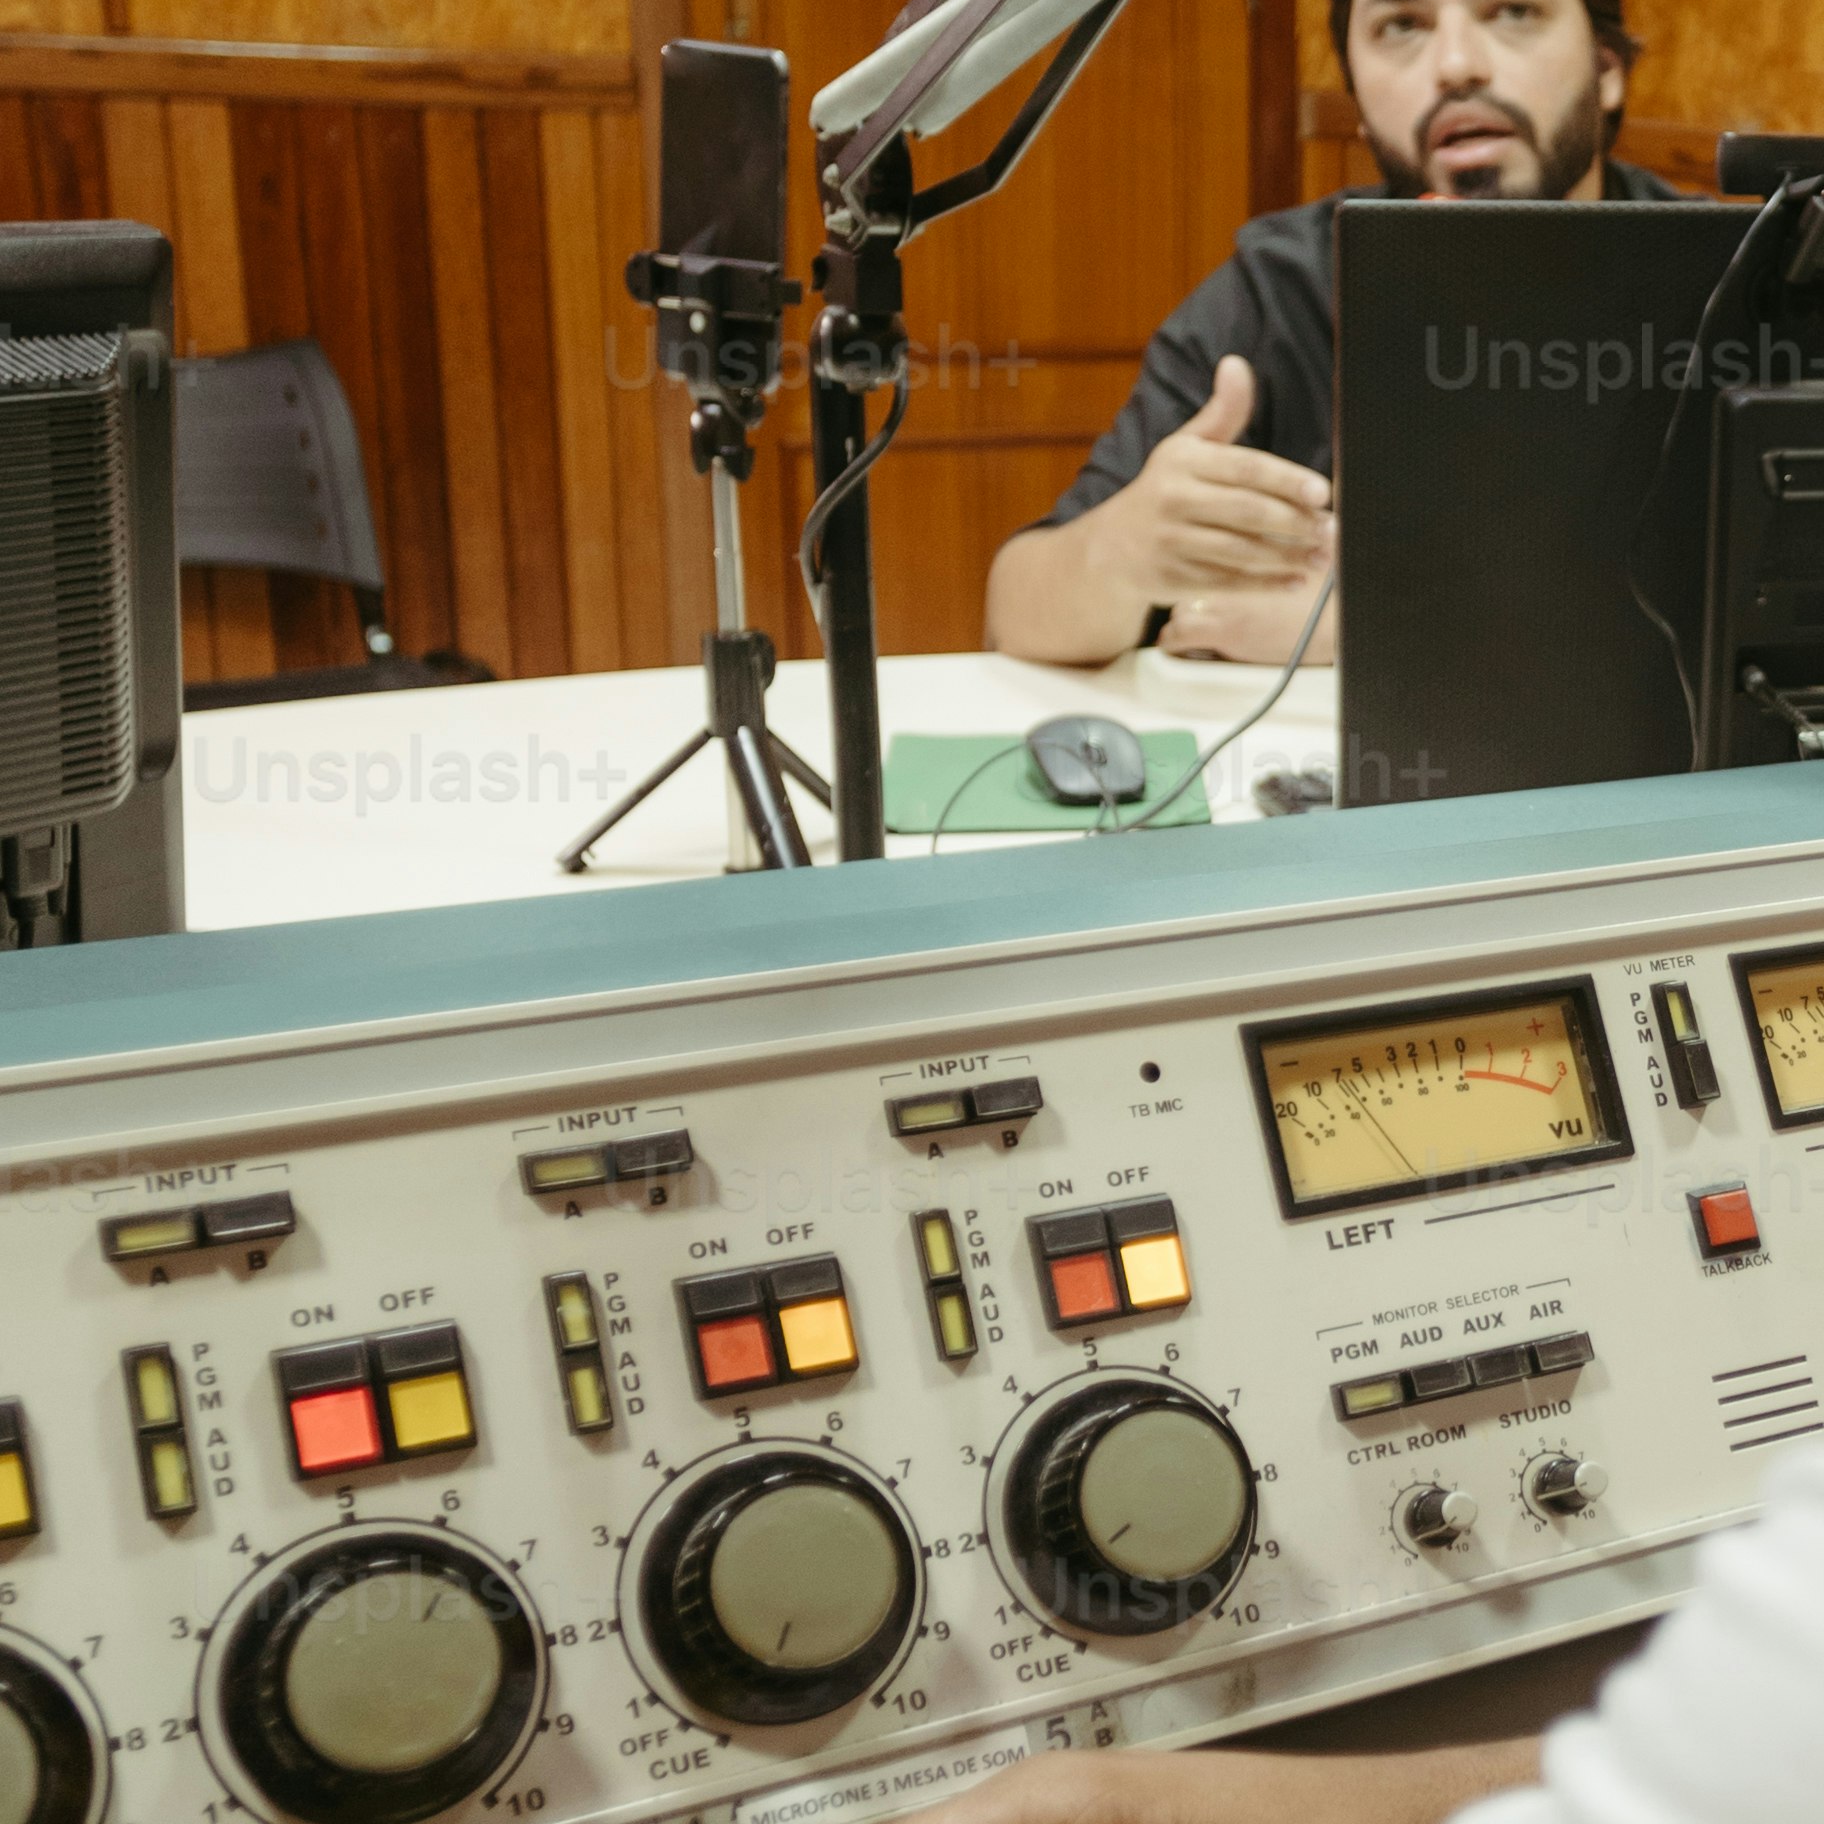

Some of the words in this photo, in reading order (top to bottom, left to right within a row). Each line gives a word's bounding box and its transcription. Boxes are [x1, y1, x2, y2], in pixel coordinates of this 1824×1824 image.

[1622, 961, 1642, 976] VU
[1649, 954, 1696, 974] METER
[919, 1055, 990, 1079] INPUT
[1276, 1101, 1298, 1118] 20
[1303, 1081, 1322, 1097] 10
[1331, 1068, 1343, 1083] 7
[1352, 1058, 1363, 1073] 5
[1386, 1046, 1397, 1061] 3
[1406, 1041, 1418, 1058] 2
[1428, 1039, 1438, 1055] 1
[1455, 1038, 1466, 1054] 0
[1486, 1041, 1494, 1055] 1
[1521, 1048, 1532, 1064] 2
[1557, 1061, 1568, 1076] 3
[558, 1107, 636, 1133] INPUT
[1128, 1101, 1148, 1119] TB
[1154, 1098, 1184, 1117] MIC
[927, 1142, 943, 1161] A
[1002, 1131, 1019, 1148] B
[144, 1165, 236, 1193] INPUT
[1038, 1178, 1074, 1199] ON
[1107, 1164, 1150, 1186] OFF
[565, 1200, 584, 1219] A
[649, 1186, 667, 1206] B
[689, 1237, 728, 1259] ON
[765, 1223, 814, 1245] OFF
[1326, 1219, 1396, 1251] LEFT
[150, 1266, 169, 1286] A
[248, 1251, 267, 1270] B
[1701, 1252, 1774, 1280] TALKBACK
[291, 1304, 334, 1327] ON
[380, 1288, 436, 1311] OFF
[1372, 1299, 1438, 1325] MONITOR
[1445, 1284, 1520, 1310] SELECTOR
[1330, 1338, 1379, 1363] PGM
[1400, 1325, 1443, 1349] AUD
[1462, 1311, 1506, 1334] AUX
[1528, 1298, 1564, 1321] AIR
[1083, 1337, 1098, 1358] 5
[1164, 1342, 1180, 1363] 6
[1003, 1375, 1019, 1395] 4
[1228, 1387, 1244, 1408] 7
[1499, 1398, 1573, 1429] STUDIO
[960, 1446, 976, 1466] 3
[1346, 1440, 1403, 1466] CTRL
[1407, 1423, 1467, 1456] ROOM
[1264, 1463, 1279, 1482] 8
[337, 1487, 354, 1509] 5
[442, 1489, 460, 1510] 6
[230, 1535, 249, 1555] 4
[520, 1539, 538, 1562] 7
[959, 1535, 976, 1553] 2
[1264, 1539, 1281, 1559] 9
[994, 1605, 1010, 1626] 1
[1229, 1603, 1261, 1626] 10
[170, 1617, 190, 1641] 3
[560, 1624, 578, 1646] 8
[990, 1635, 1033, 1661] OFF
[1016, 1653, 1071, 1683] CUE
[1091, 1701, 1108, 1721] A
[163, 1721, 182, 1740] 2
[557, 1714, 576, 1735] 9
[1045, 1716, 1071, 1750] 5
[619, 1728, 669, 1757] OFF
[1095, 1727, 1114, 1747] B
[649, 1748, 712, 1779] CUE
[876, 1779, 889, 1798] 3
[893, 1766, 949, 1794] MESA
[953, 1759, 979, 1778] DE
[981, 1744, 1027, 1774] SOM
[201, 1802, 219, 1824] 1
[505, 1789, 546, 1816] 10
